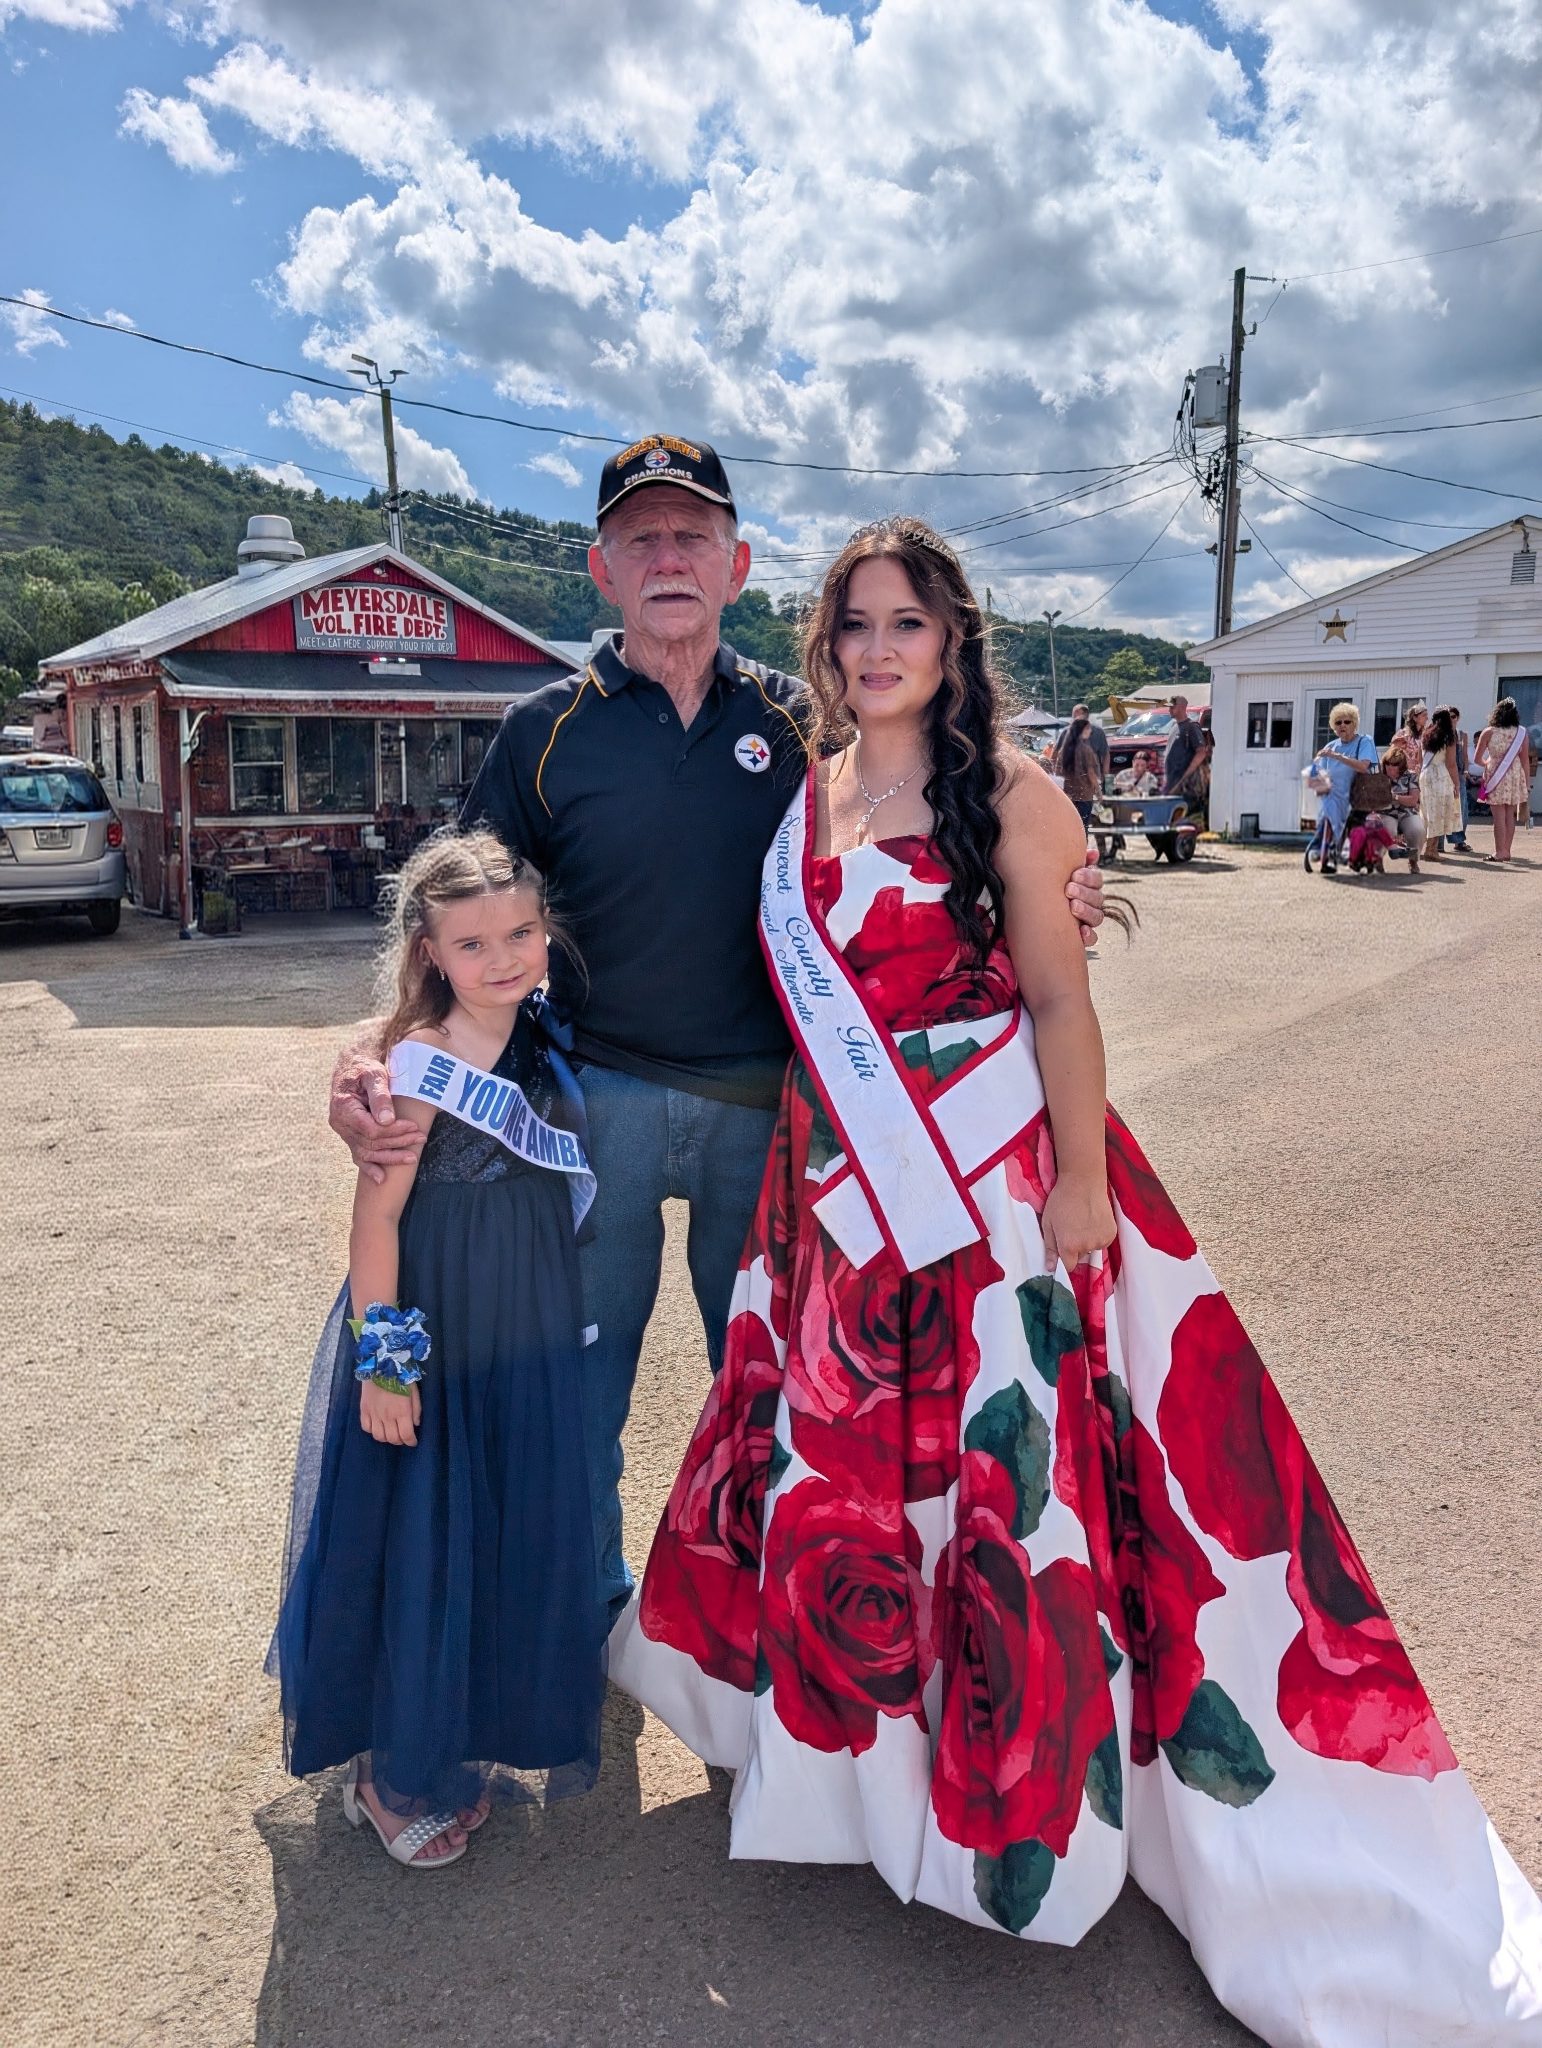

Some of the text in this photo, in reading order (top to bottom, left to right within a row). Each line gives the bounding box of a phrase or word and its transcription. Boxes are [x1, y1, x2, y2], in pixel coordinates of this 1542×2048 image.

[617, 438, 660, 469] SUPER
[624, 468, 692, 486] CHAMPIONS
[302, 588, 446, 624] MEYERSDALE
[299, 637, 321, 648] MEET
[328, 638, 341, 648] EAT
[344, 638, 362, 649] HERE
[366, 640, 397, 650] SUPPORT
[400, 640, 418, 652] YOUR
[420, 641, 436, 652] FIRE
[311, 614, 447, 640] VOL. FIRE DEPT.
[762, 880, 814, 1026] Second Alternate
[777, 814, 880, 1083] Somerset County Fair
[418, 1054, 457, 1102] FAIR
[456, 1070, 529, 1151] YOUNG
